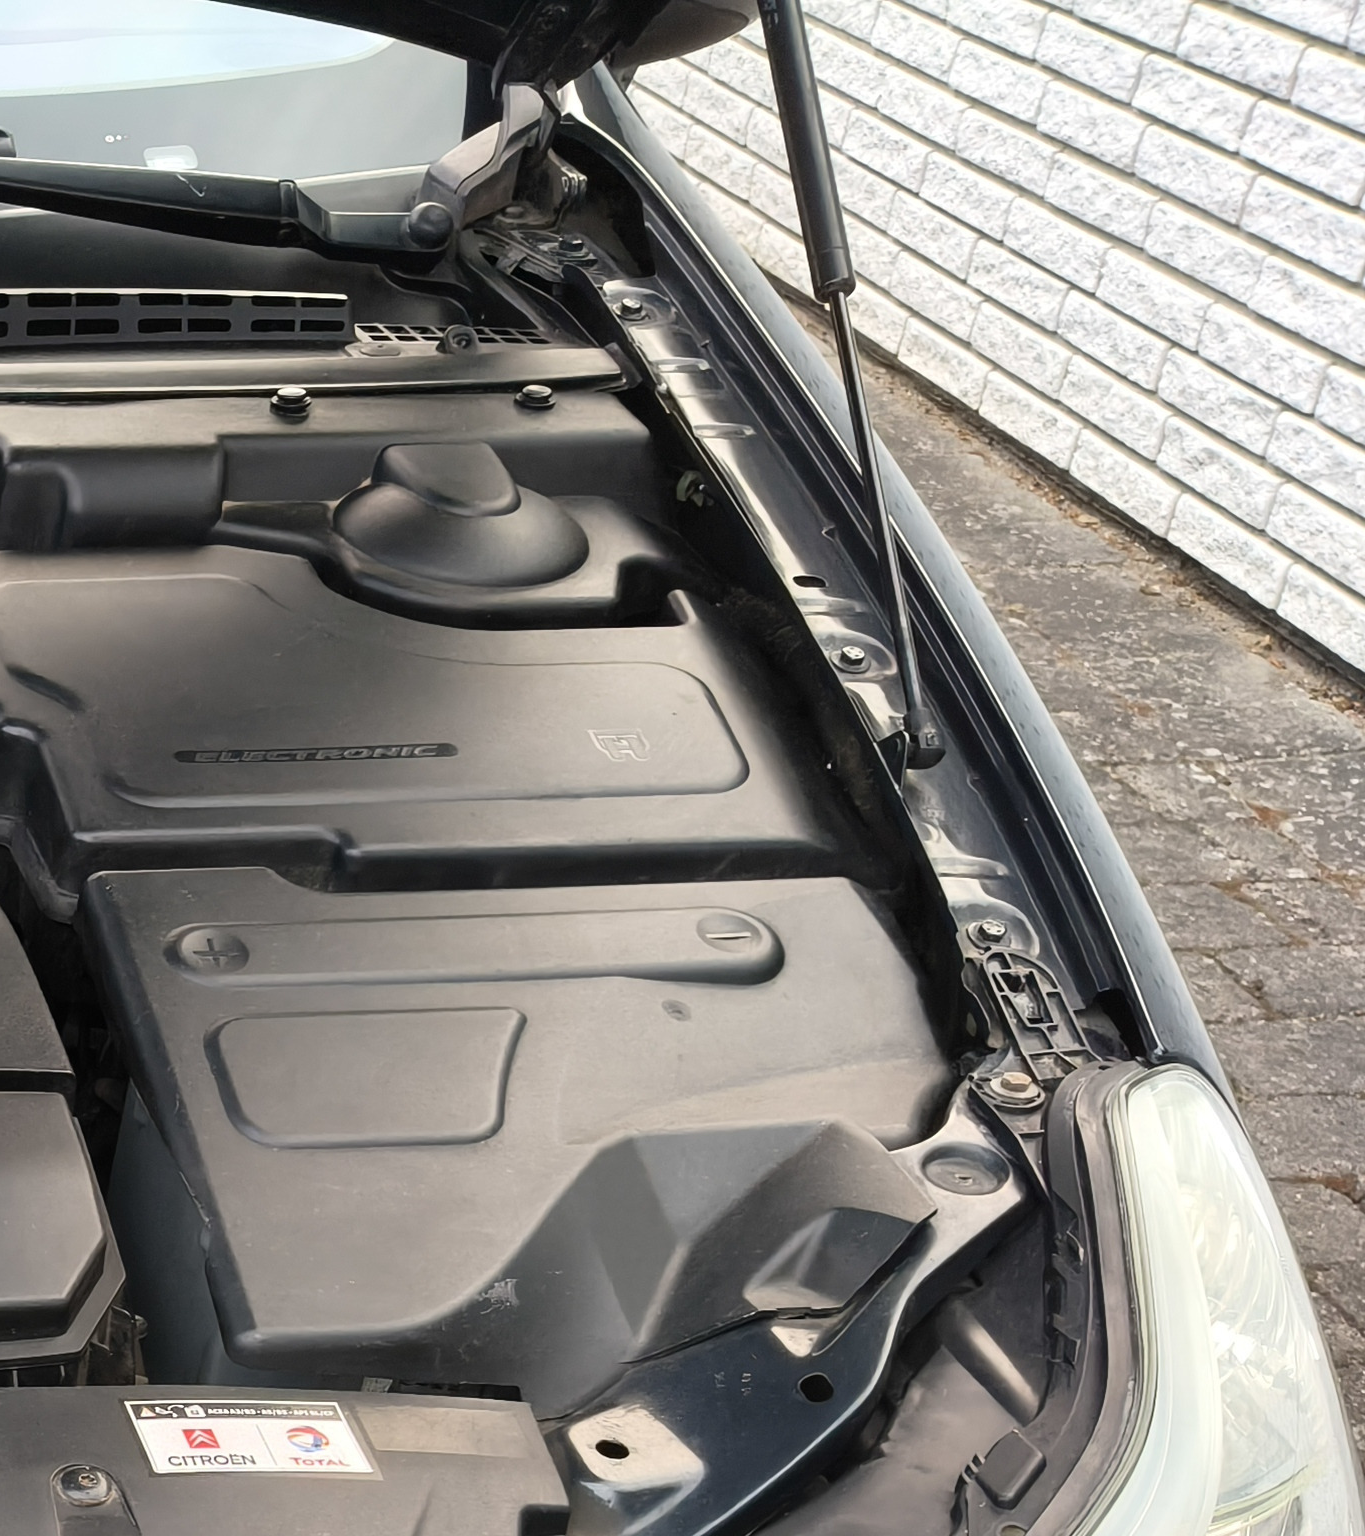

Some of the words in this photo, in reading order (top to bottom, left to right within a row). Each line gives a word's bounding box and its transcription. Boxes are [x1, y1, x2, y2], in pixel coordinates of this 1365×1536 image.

[194, 742, 439, 764] ELECTRONIC
[168, 1453, 257, 1467] CITROËN
[289, 1456, 351, 1467] TOTAL
